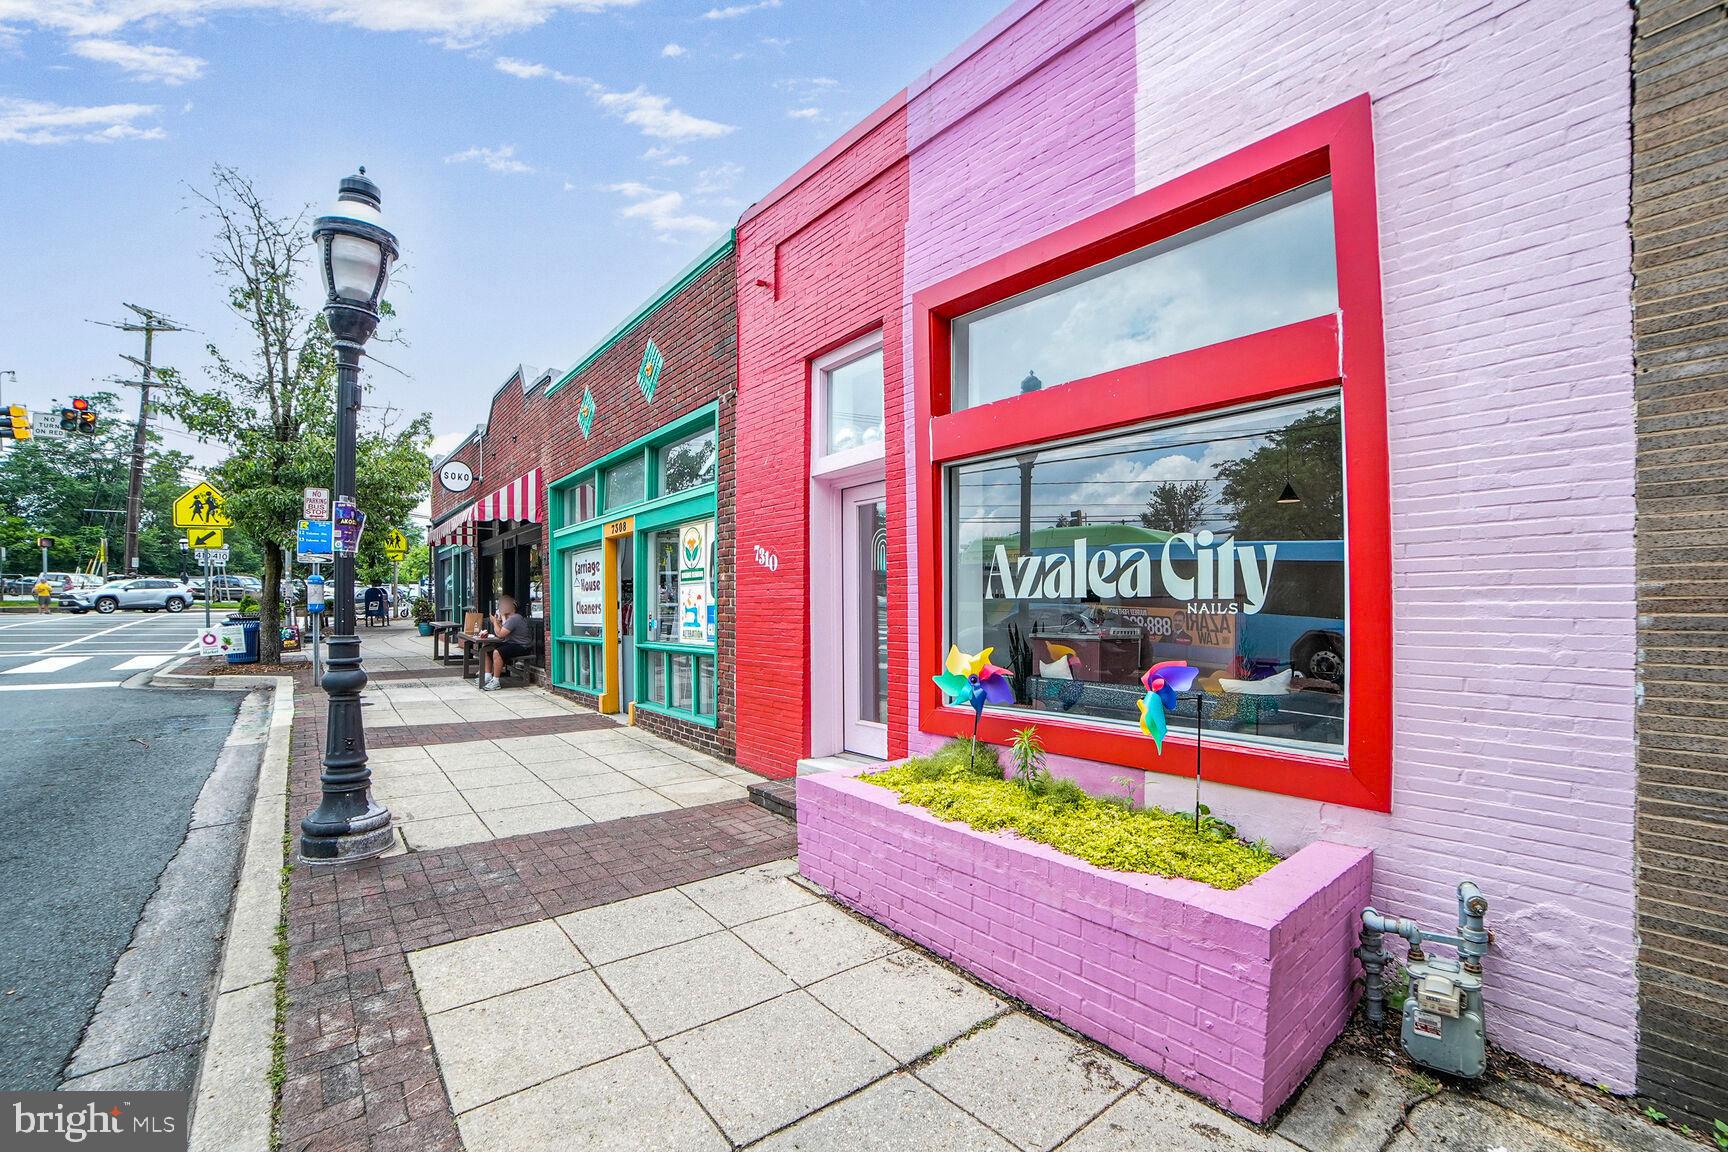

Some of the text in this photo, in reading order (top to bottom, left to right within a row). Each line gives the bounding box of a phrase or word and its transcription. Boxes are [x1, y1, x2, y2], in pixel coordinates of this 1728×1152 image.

[443, 471, 470, 482] SOKO
[611, 521, 627, 535] 7308
[753, 544, 778, 572] 7310
[574, 559, 601, 577] Carriage
[985, 530, 1277, 615] Azalea City
[580, 579, 601, 593] House
[576, 601, 602, 615] Cleaners
[1187, 602, 1239, 615] NAILS
